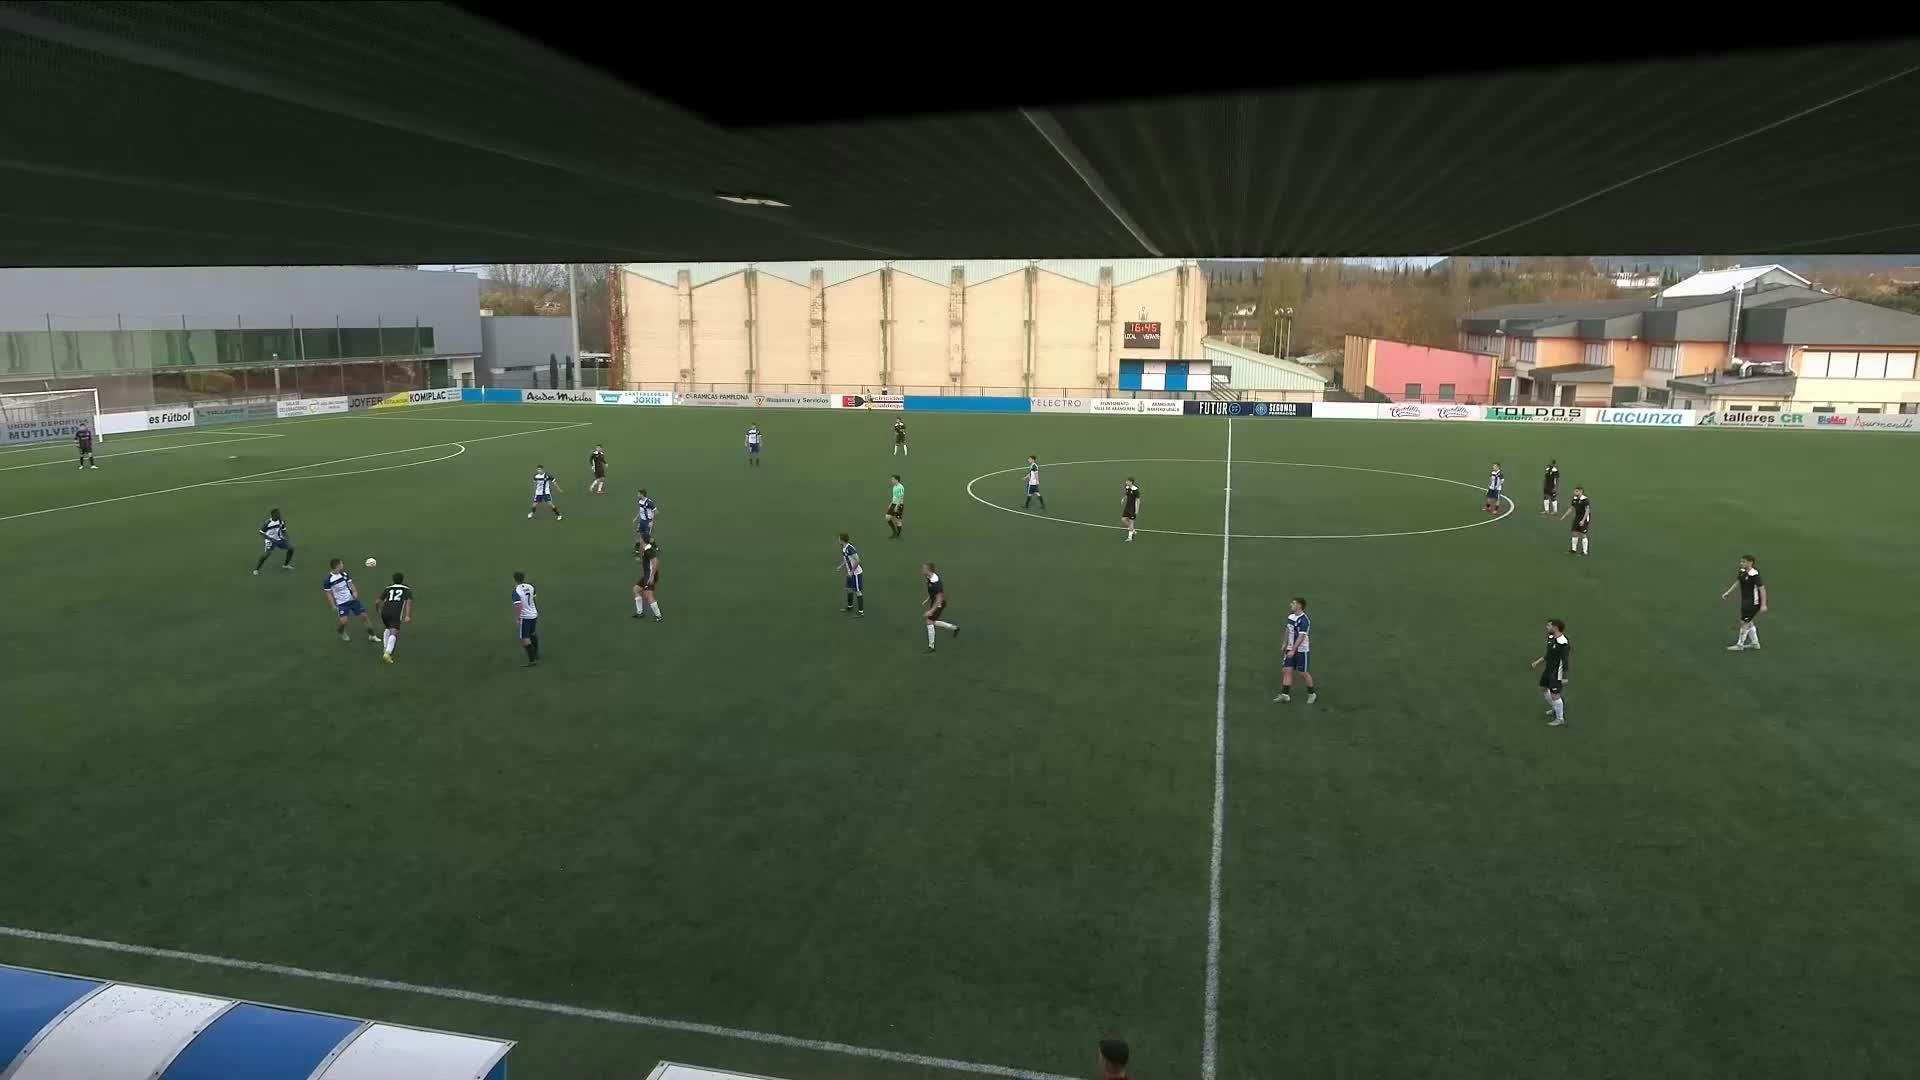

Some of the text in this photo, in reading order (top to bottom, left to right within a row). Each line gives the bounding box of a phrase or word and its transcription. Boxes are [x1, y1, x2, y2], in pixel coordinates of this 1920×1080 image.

[1131, 323, 1157, 332] 16:45
[350, 397, 383, 408] JOYFER
[409, 391, 447, 403] KOMIPLAC
[1269, 403, 1297, 412] SEGUNDA
[1494, 407, 1581, 418] TOLDOS
[148, 412, 191, 425] es Fútbol
[1601, 410, 1683, 425] Lacunza
[1724, 412, 1804, 423] talleres CR
[1817, 415, 1847, 425] BigMat
[388, 589, 404, 602] 12
[525, 592, 531, 606] 7
